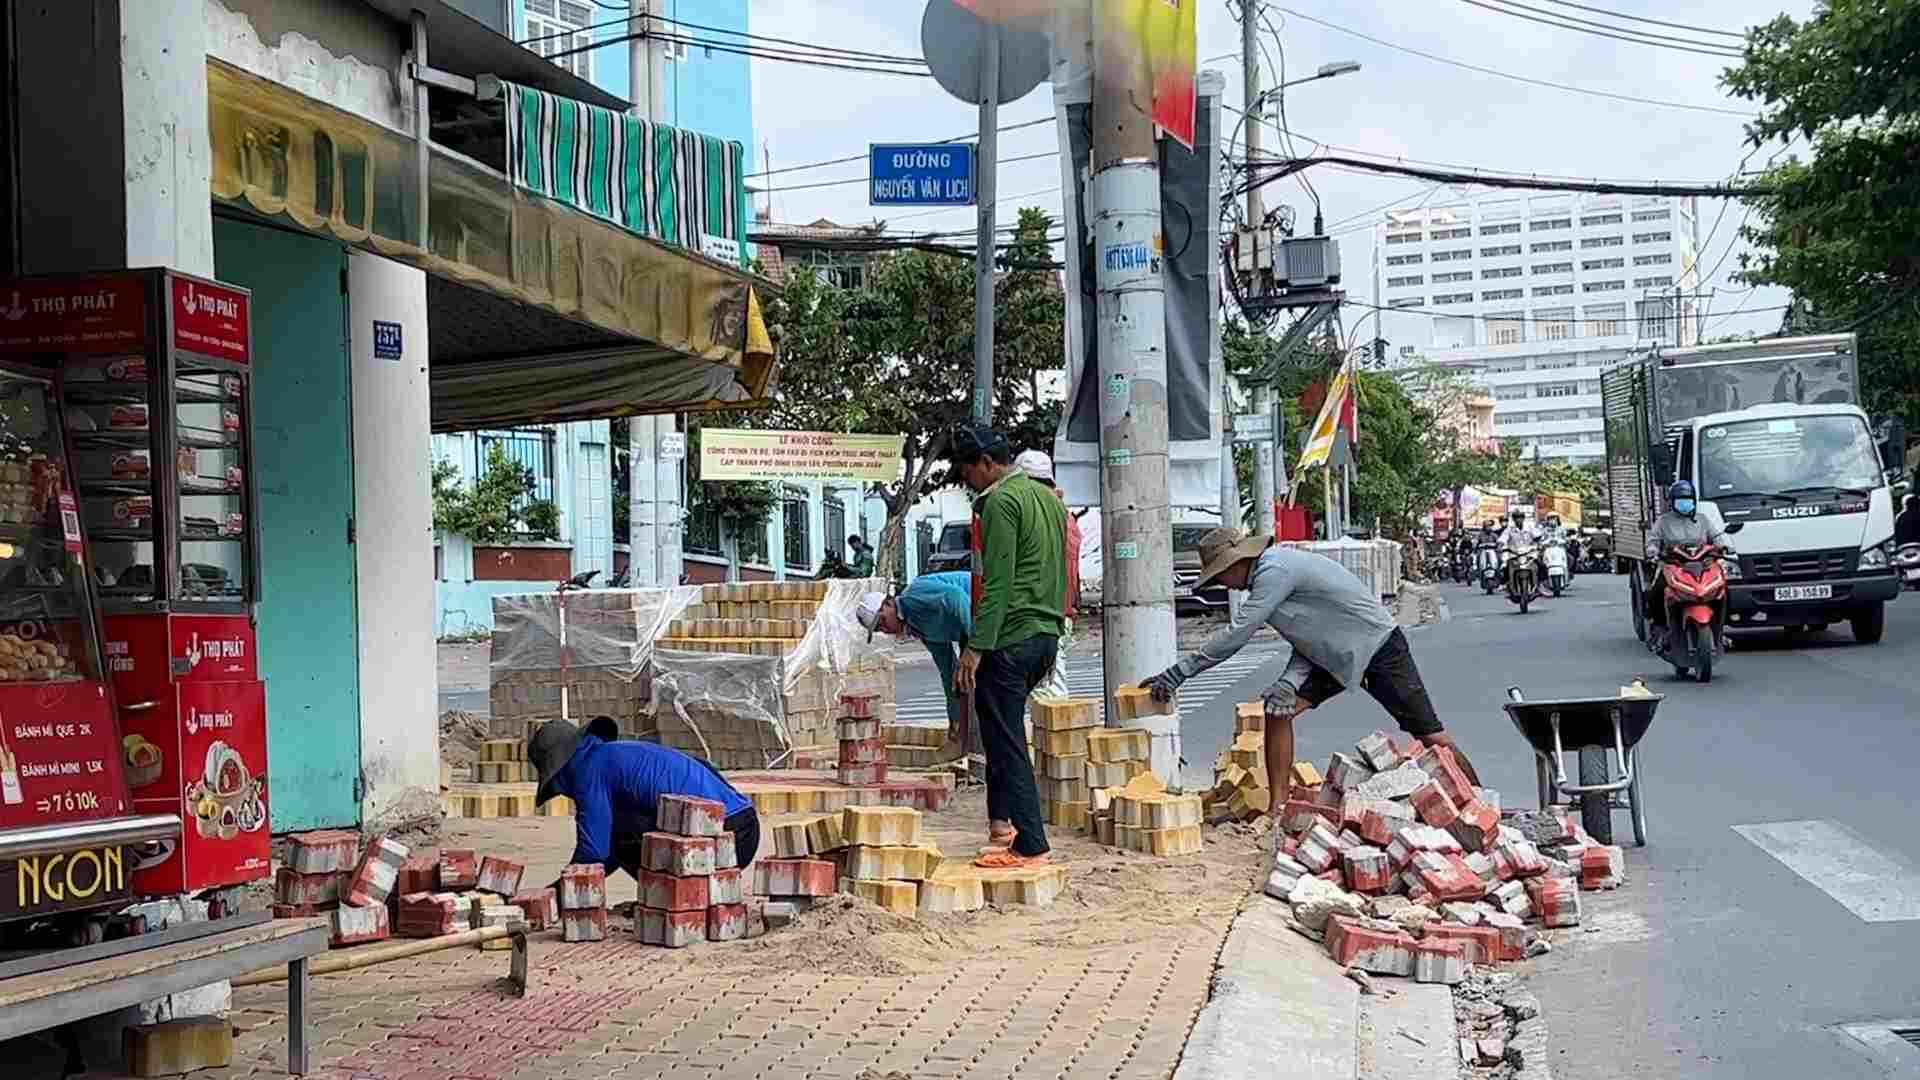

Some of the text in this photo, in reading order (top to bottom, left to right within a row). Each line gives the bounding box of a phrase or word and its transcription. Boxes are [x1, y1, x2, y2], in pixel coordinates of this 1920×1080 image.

[892, 149, 951, 169] ĐƯỜNG
[874, 174, 969, 201] NGUYỄN VĂN LỊCH
[31, 289, 118, 316] THỌ PHÁT
[197, 293, 239, 320] THỌ PHÁT
[779, 434, 833, 446] LỄ KHỞI CÔNG
[1772, 506, 1820, 518] ISUZU
[203, 635, 245, 662] THỌ PHÁT
[15, 722, 41, 738] BÁNH
[42, 722, 53, 737] MÌ
[56, 723, 76, 738] QUE
[199, 709, 233, 731] THỌ PHÁT
[21, 762, 48, 776] BÁNH
[48, 760, 60, 774] MÌ
[60, 762, 80, 774] MINI
[18, 846, 124, 907] NGON
